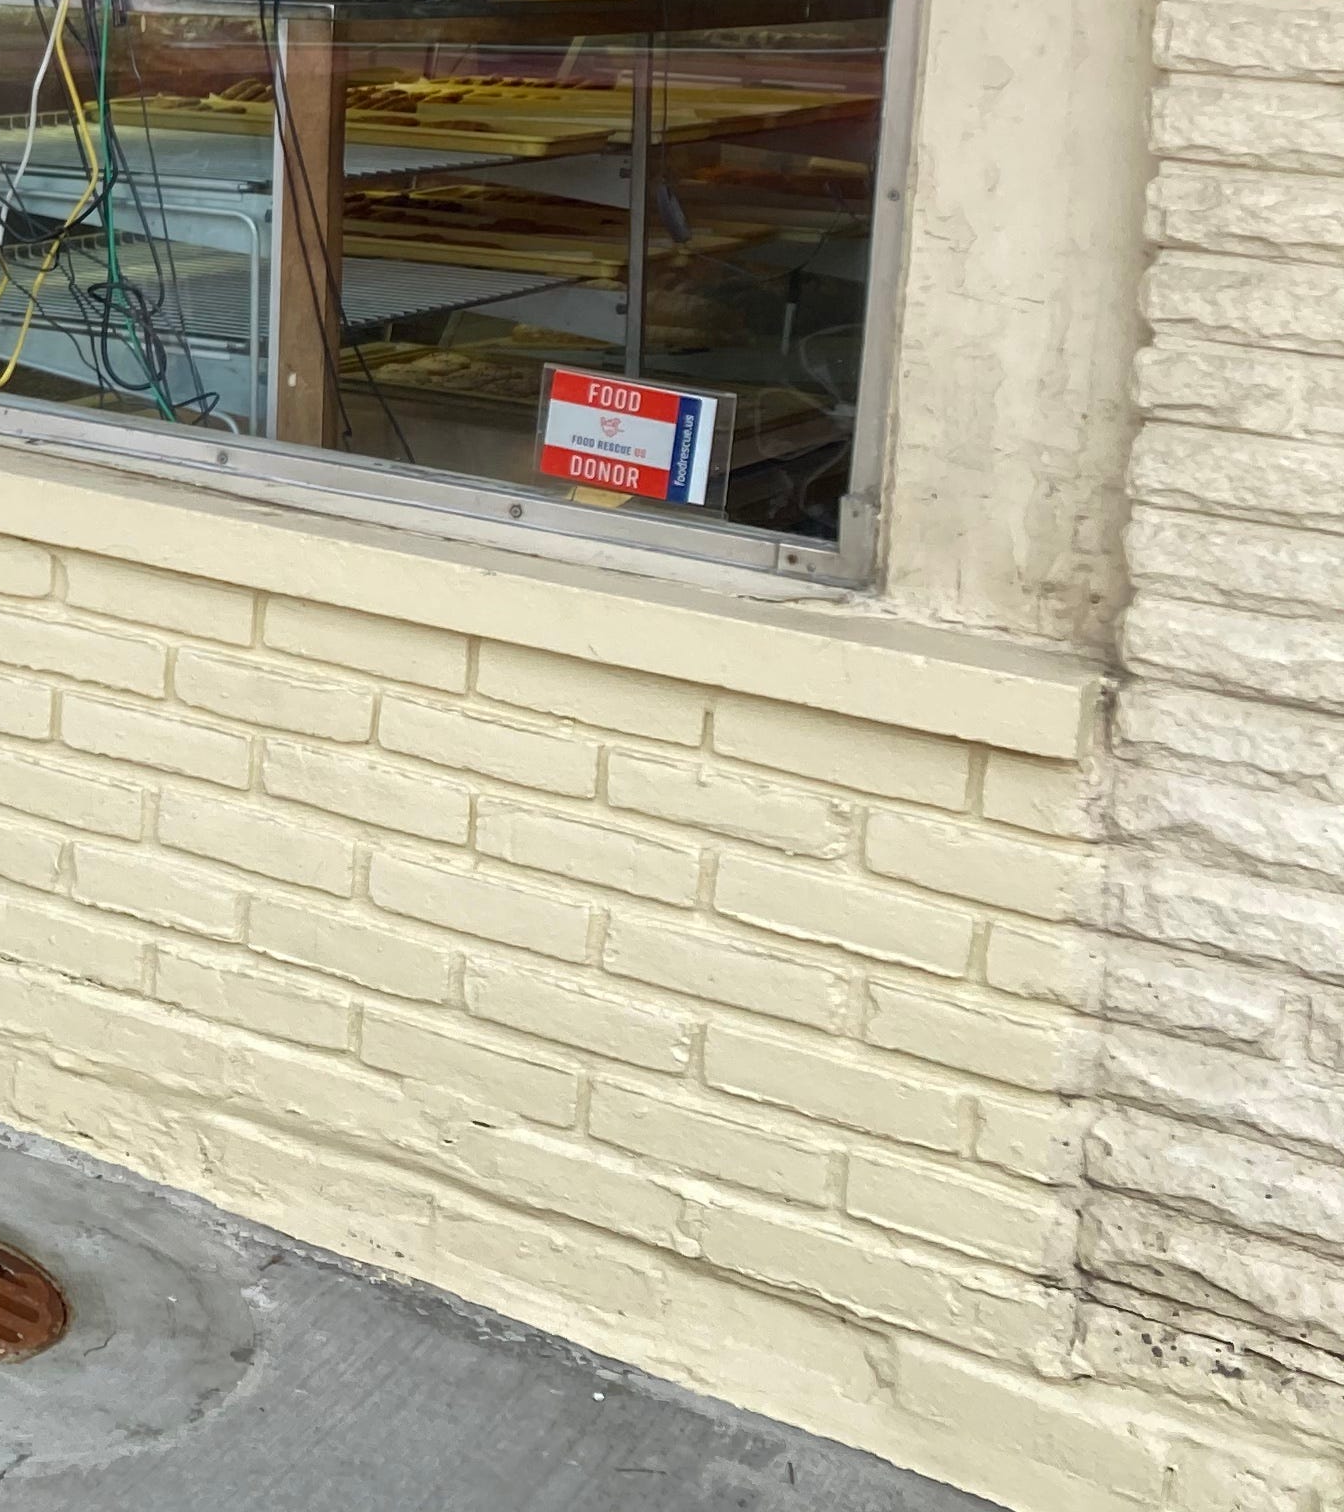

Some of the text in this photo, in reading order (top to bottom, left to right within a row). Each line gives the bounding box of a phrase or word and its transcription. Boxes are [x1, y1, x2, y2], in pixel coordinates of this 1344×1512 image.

[588, 383, 642, 412] FOOD
[571, 434, 595, 448] FOOD
[597, 438, 632, 456] RESCUE
[673, 414, 695, 487] foodrescue.us
[570, 455, 640, 489] DONOR
